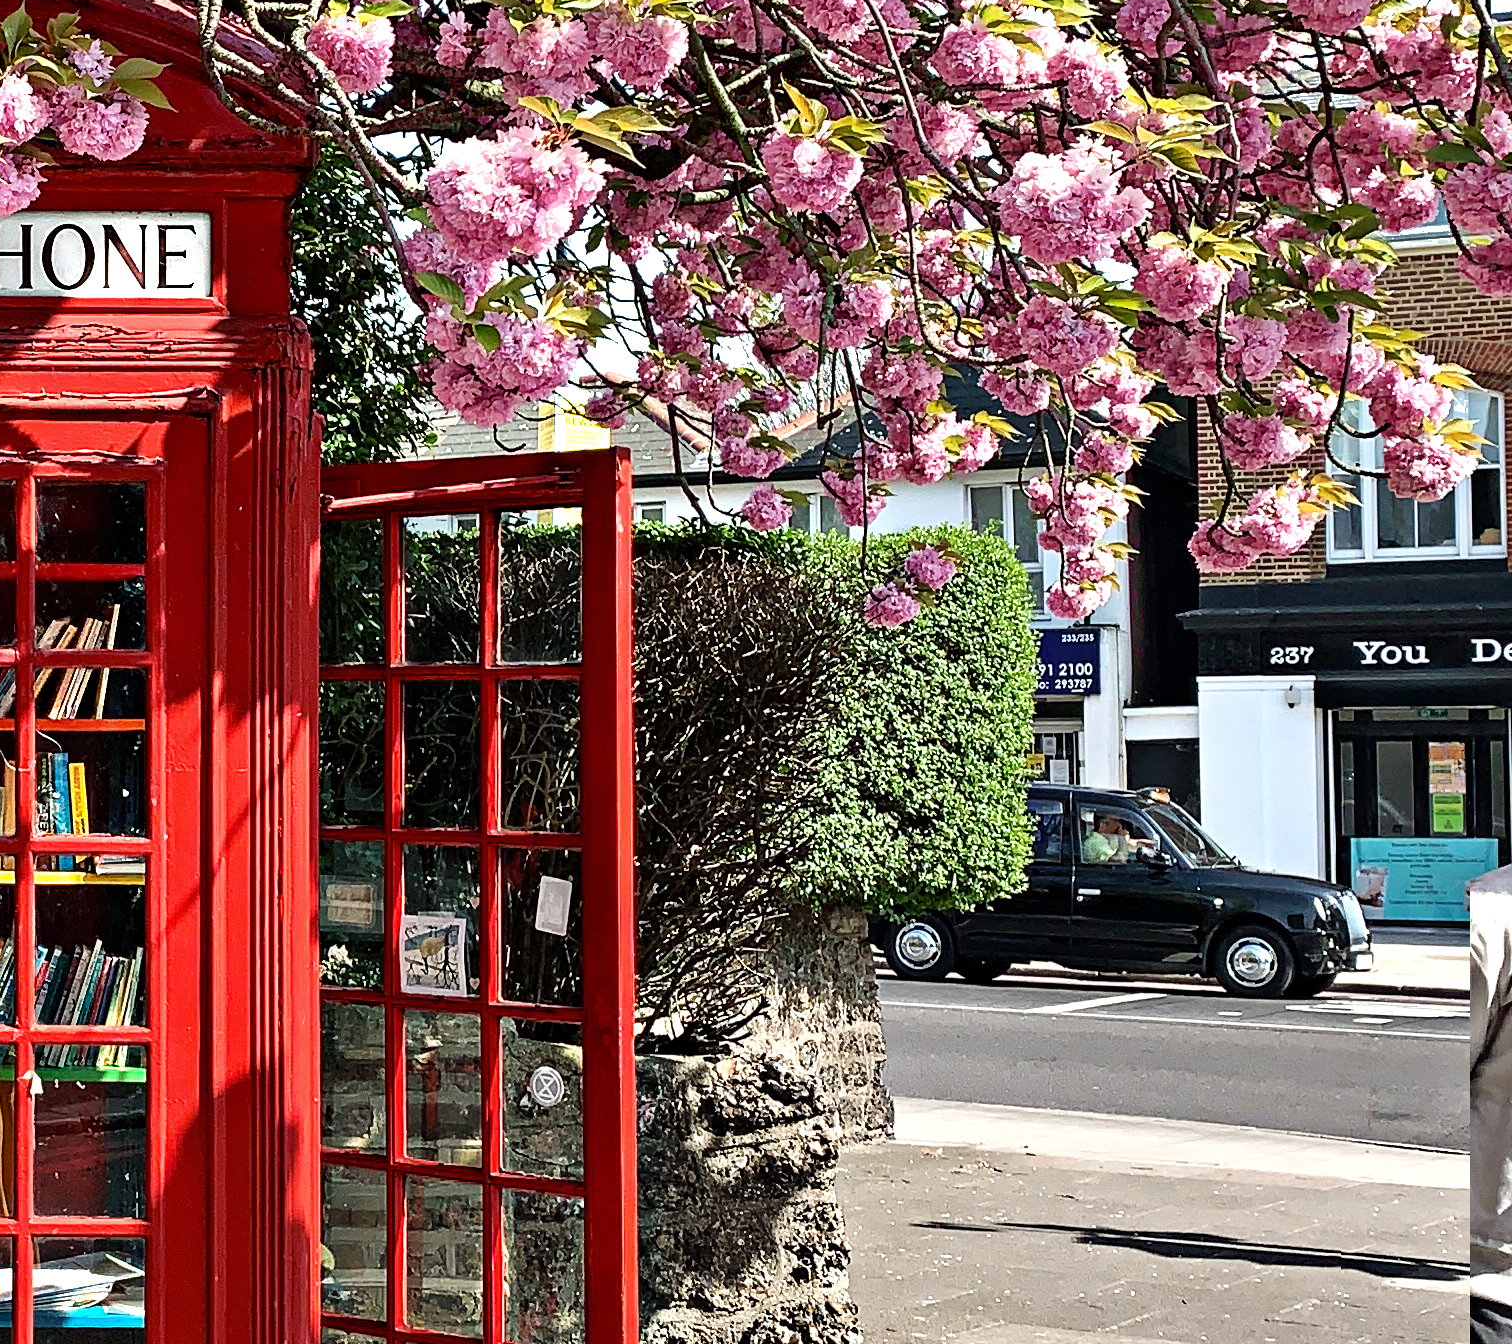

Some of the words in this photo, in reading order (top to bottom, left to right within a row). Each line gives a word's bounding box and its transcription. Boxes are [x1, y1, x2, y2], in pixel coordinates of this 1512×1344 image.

[1061, 633, 1095, 643] 233/235
[1269, 646, 1315, 665] 237
[1352, 641, 1431, 665] You
[1038, 663, 1053, 676] 91
[1058, 662, 1093, 676] 2100
[1054, 678, 1093, 689] 293787
